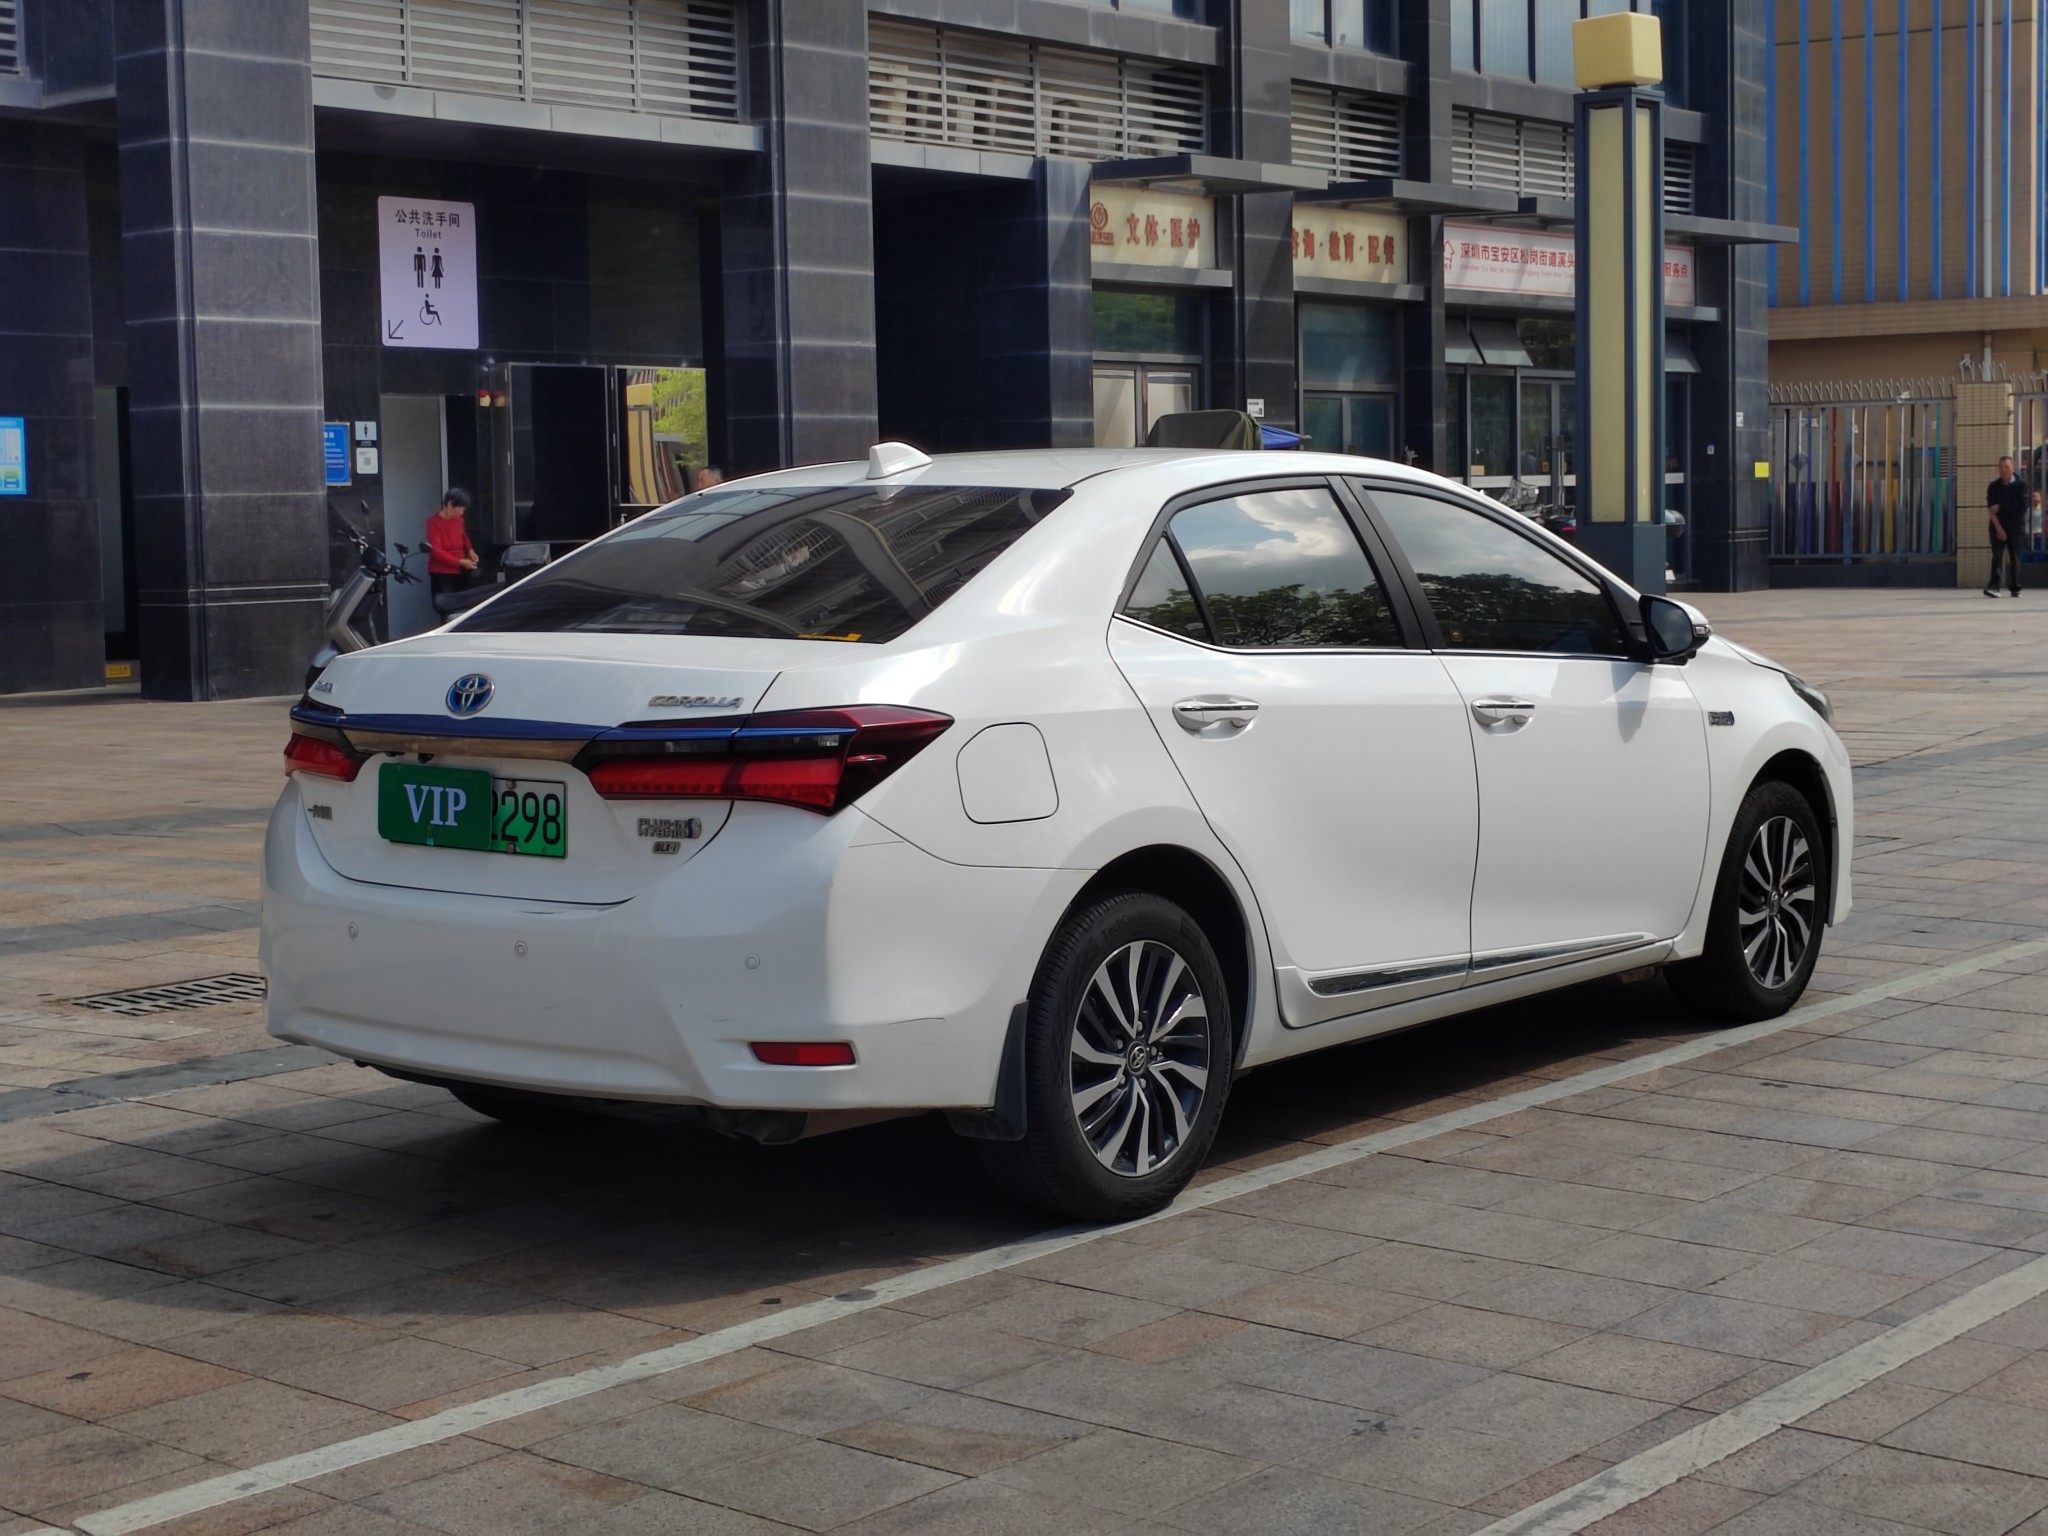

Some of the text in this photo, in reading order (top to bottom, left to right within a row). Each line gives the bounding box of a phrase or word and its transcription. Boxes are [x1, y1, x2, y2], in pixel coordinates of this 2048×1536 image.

[395, 208, 460, 228] 公共洗手间
[415, 228, 442, 239] Toilet
[648, 695, 744, 709] COROLLA
[403, 783, 467, 827] VIP
